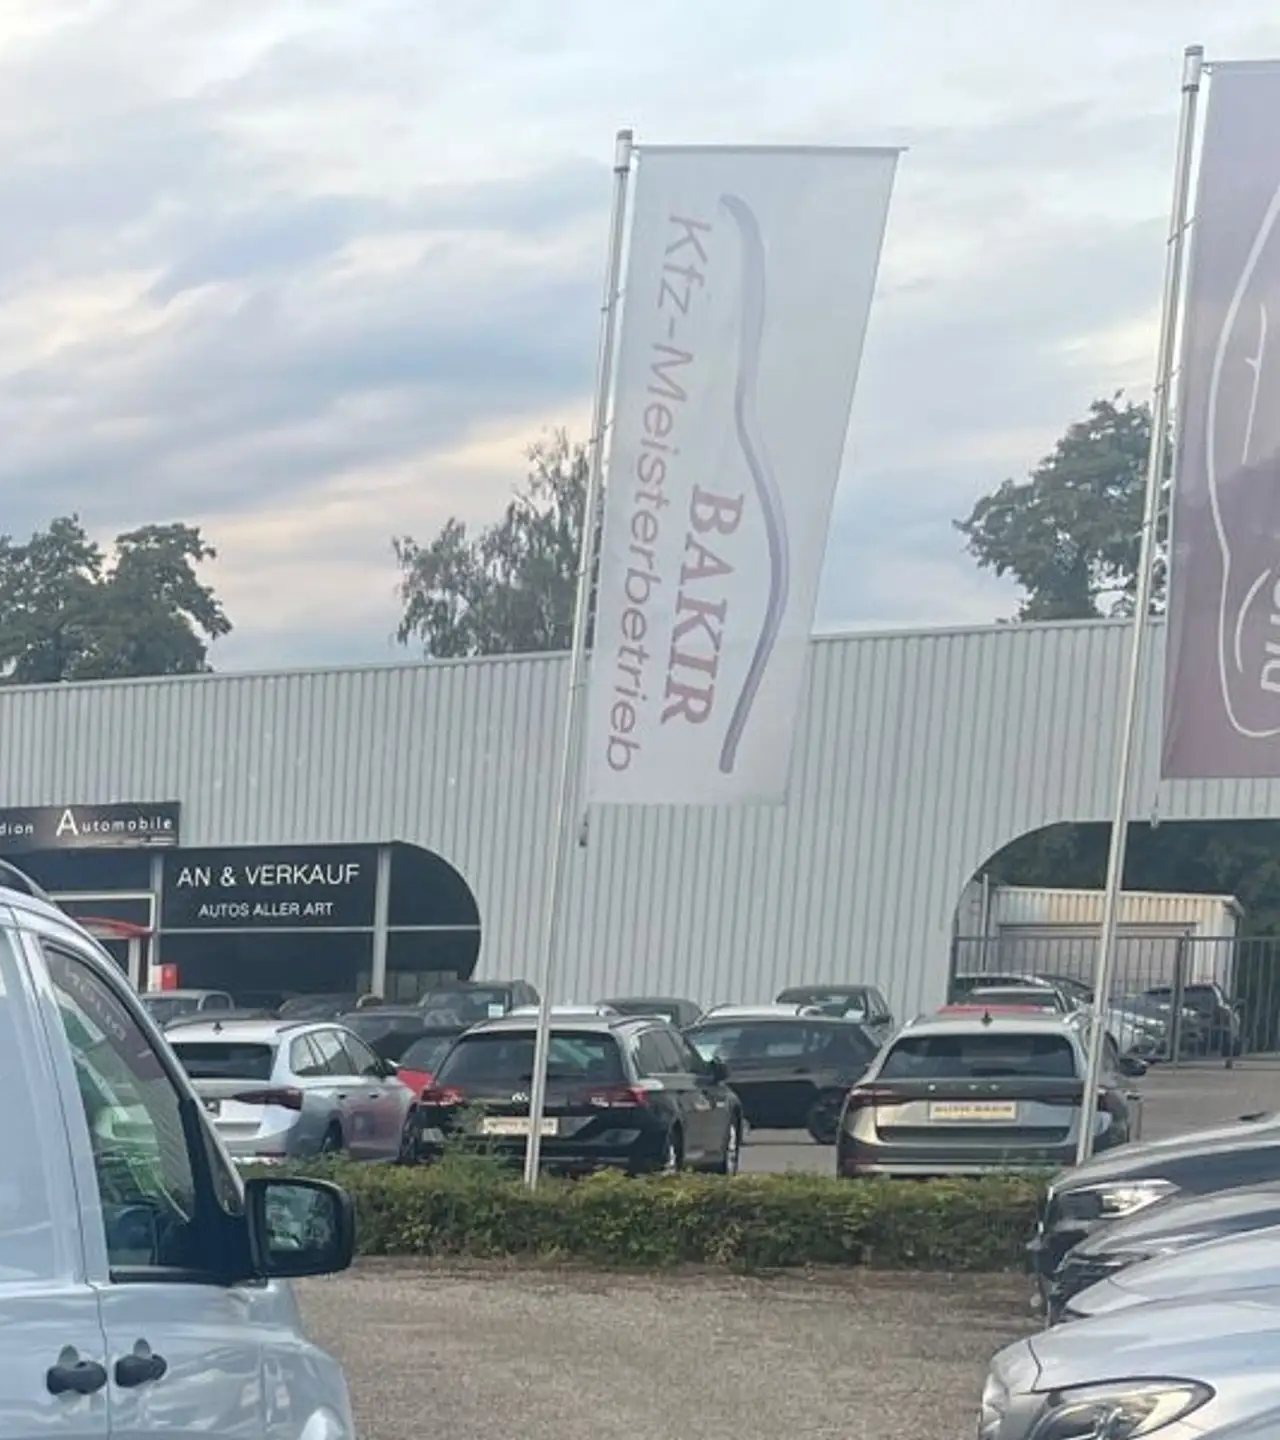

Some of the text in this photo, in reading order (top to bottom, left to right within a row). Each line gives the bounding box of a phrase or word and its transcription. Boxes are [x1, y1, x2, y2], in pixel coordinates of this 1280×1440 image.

[605, 213, 711, 773] Kfz-Meisterbetrieb
[659, 483, 745, 727] BAKIR
[56, 808, 173, 837] Automobile
[176, 863, 360, 888] AN & VERKAUF
[197, 902, 333, 918] AUTOS ALLER ART
